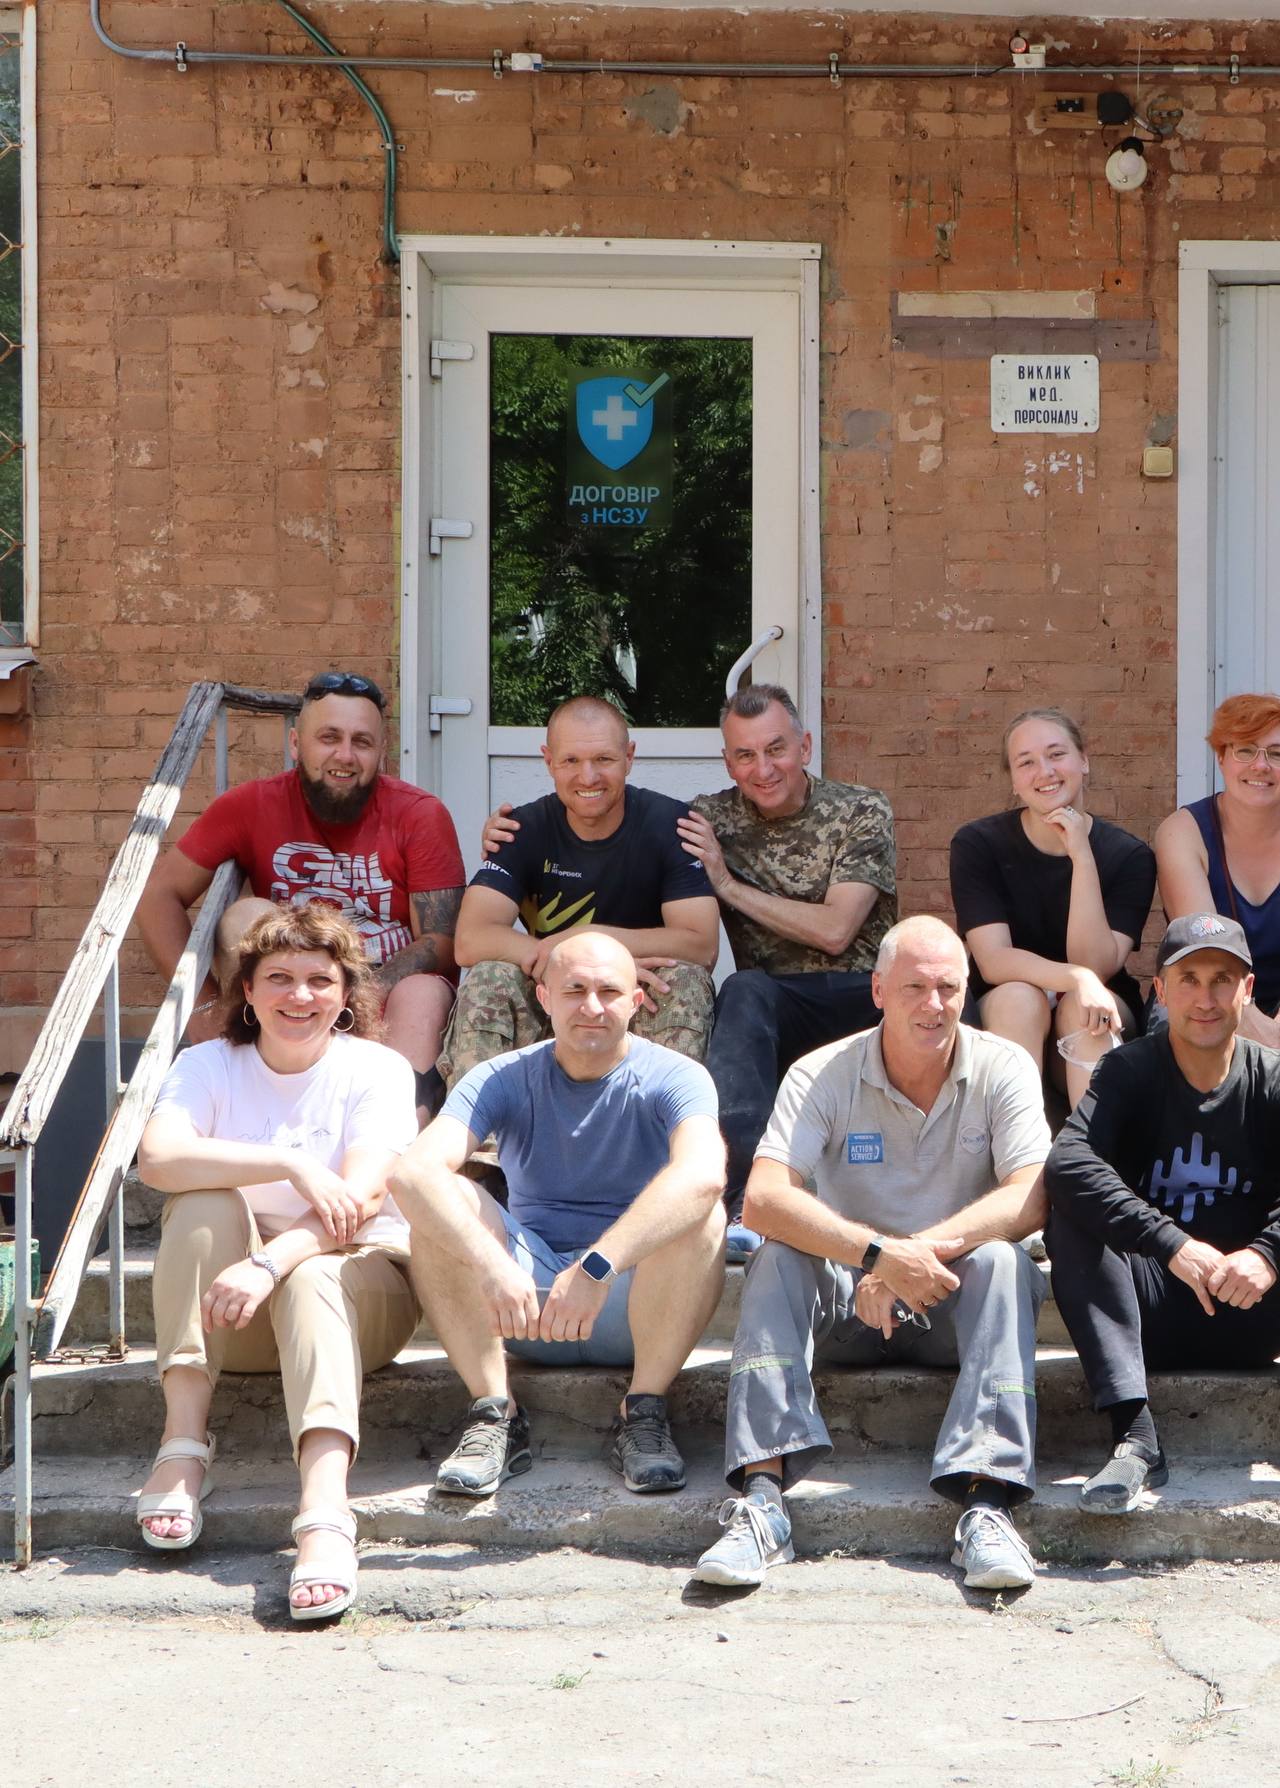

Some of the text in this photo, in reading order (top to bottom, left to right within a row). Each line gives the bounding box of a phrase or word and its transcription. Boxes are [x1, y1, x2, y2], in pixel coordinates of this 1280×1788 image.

[1018, 365, 1071, 380] ВИКЛИК
[1014, 409, 1078, 425] ПЕРСОНАЛУ
[569, 485, 660, 506] ДОГОВІР
[592, 507, 649, 524] НСЗУ
[850, 1143, 874, 1153] ACTION
[850, 1152, 874, 1161] SERVICE
